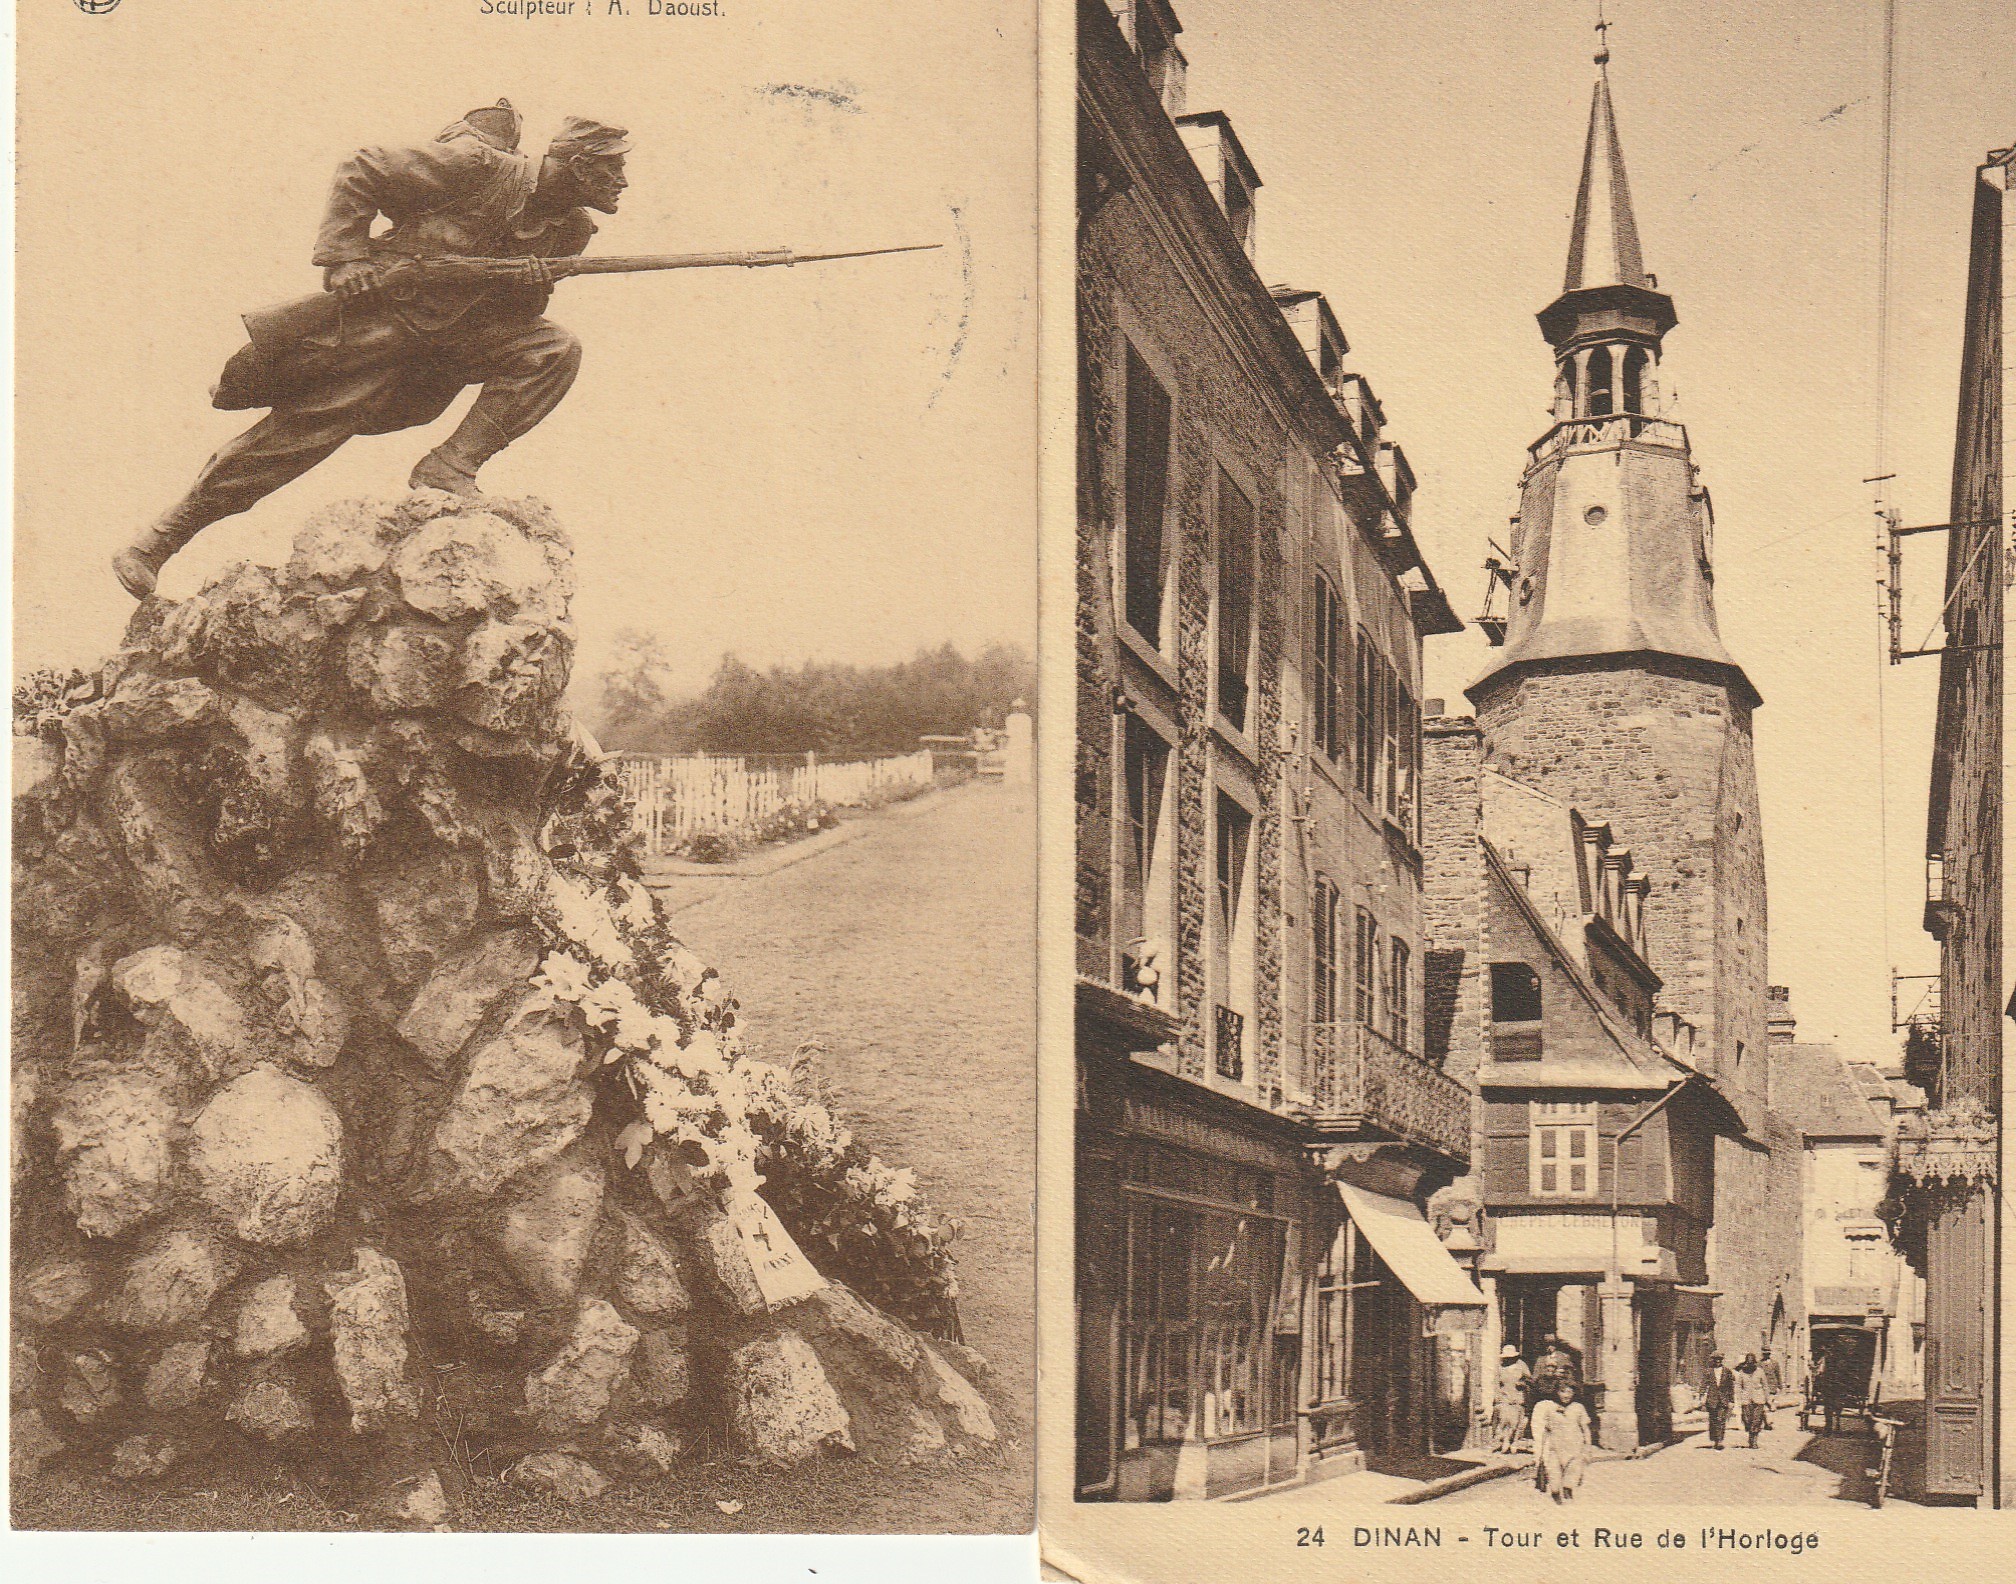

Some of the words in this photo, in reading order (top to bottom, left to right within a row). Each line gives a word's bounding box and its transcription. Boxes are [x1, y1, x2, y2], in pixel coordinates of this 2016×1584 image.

[480, 0, 575, 20] Sculpteur
[608, 0, 630, 16] A.
[648, 0, 726, 17] Daoust.
[1296, 1527, 1326, 1548] 24
[1354, 1527, 1442, 1548] DINAN
[1483, 1526, 1543, 1548] Tour
[1556, 1528, 1580, 1549] et
[1594, 1527, 1643, 1549] Rue
[1657, 1528, 1686, 1549] de
[1701, 1526, 1819, 1555] l'Horloge
